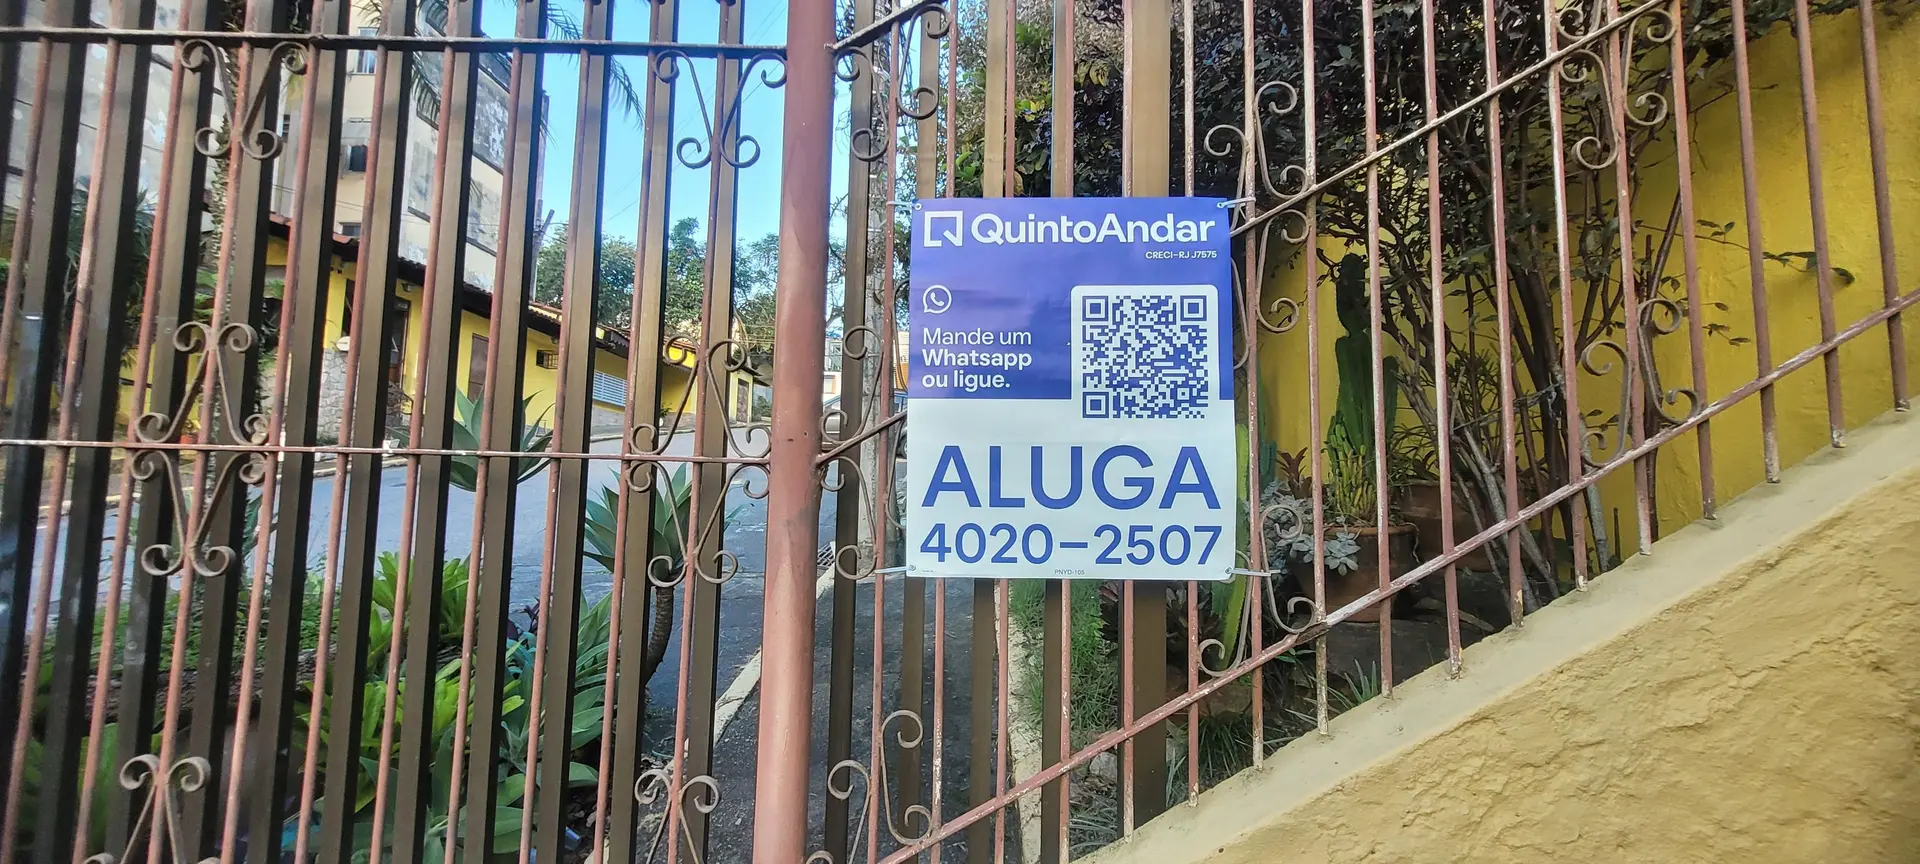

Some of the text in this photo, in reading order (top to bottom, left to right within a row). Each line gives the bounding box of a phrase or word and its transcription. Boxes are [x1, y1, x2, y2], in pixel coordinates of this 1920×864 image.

[971, 213, 1216, 246] QuintoAndar
[1191, 250, 1217, 258] J7575
[922, 328, 1032, 345] Mande um
[922, 349, 1032, 370] Whatsapp
[922, 370, 1010, 391] ou ligue.
[921, 445, 1221, 510] ALUGA
